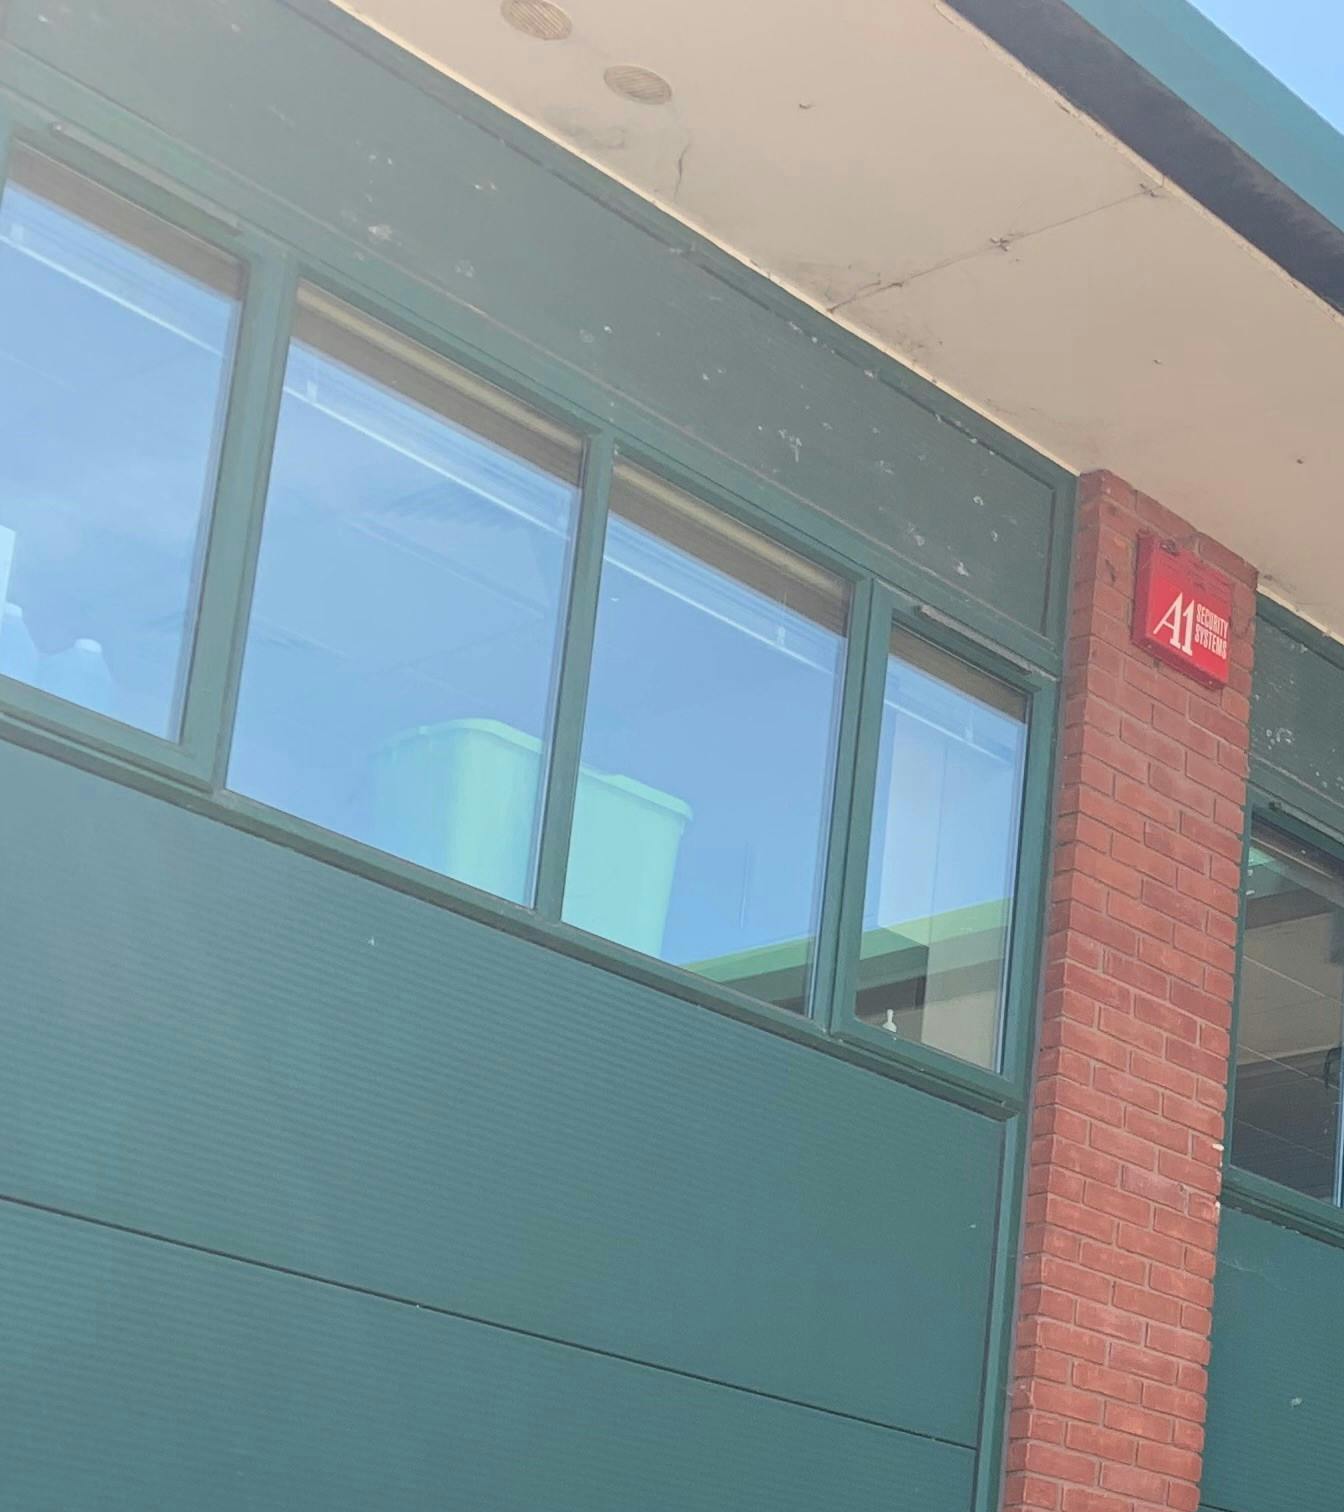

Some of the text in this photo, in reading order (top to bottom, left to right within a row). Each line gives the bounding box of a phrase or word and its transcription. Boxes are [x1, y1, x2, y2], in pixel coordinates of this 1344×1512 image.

[1152, 591, 1195, 657] A1
[1196, 603, 1229, 640] SECURITY
[1194, 623, 1227, 660] SYSTEMS
